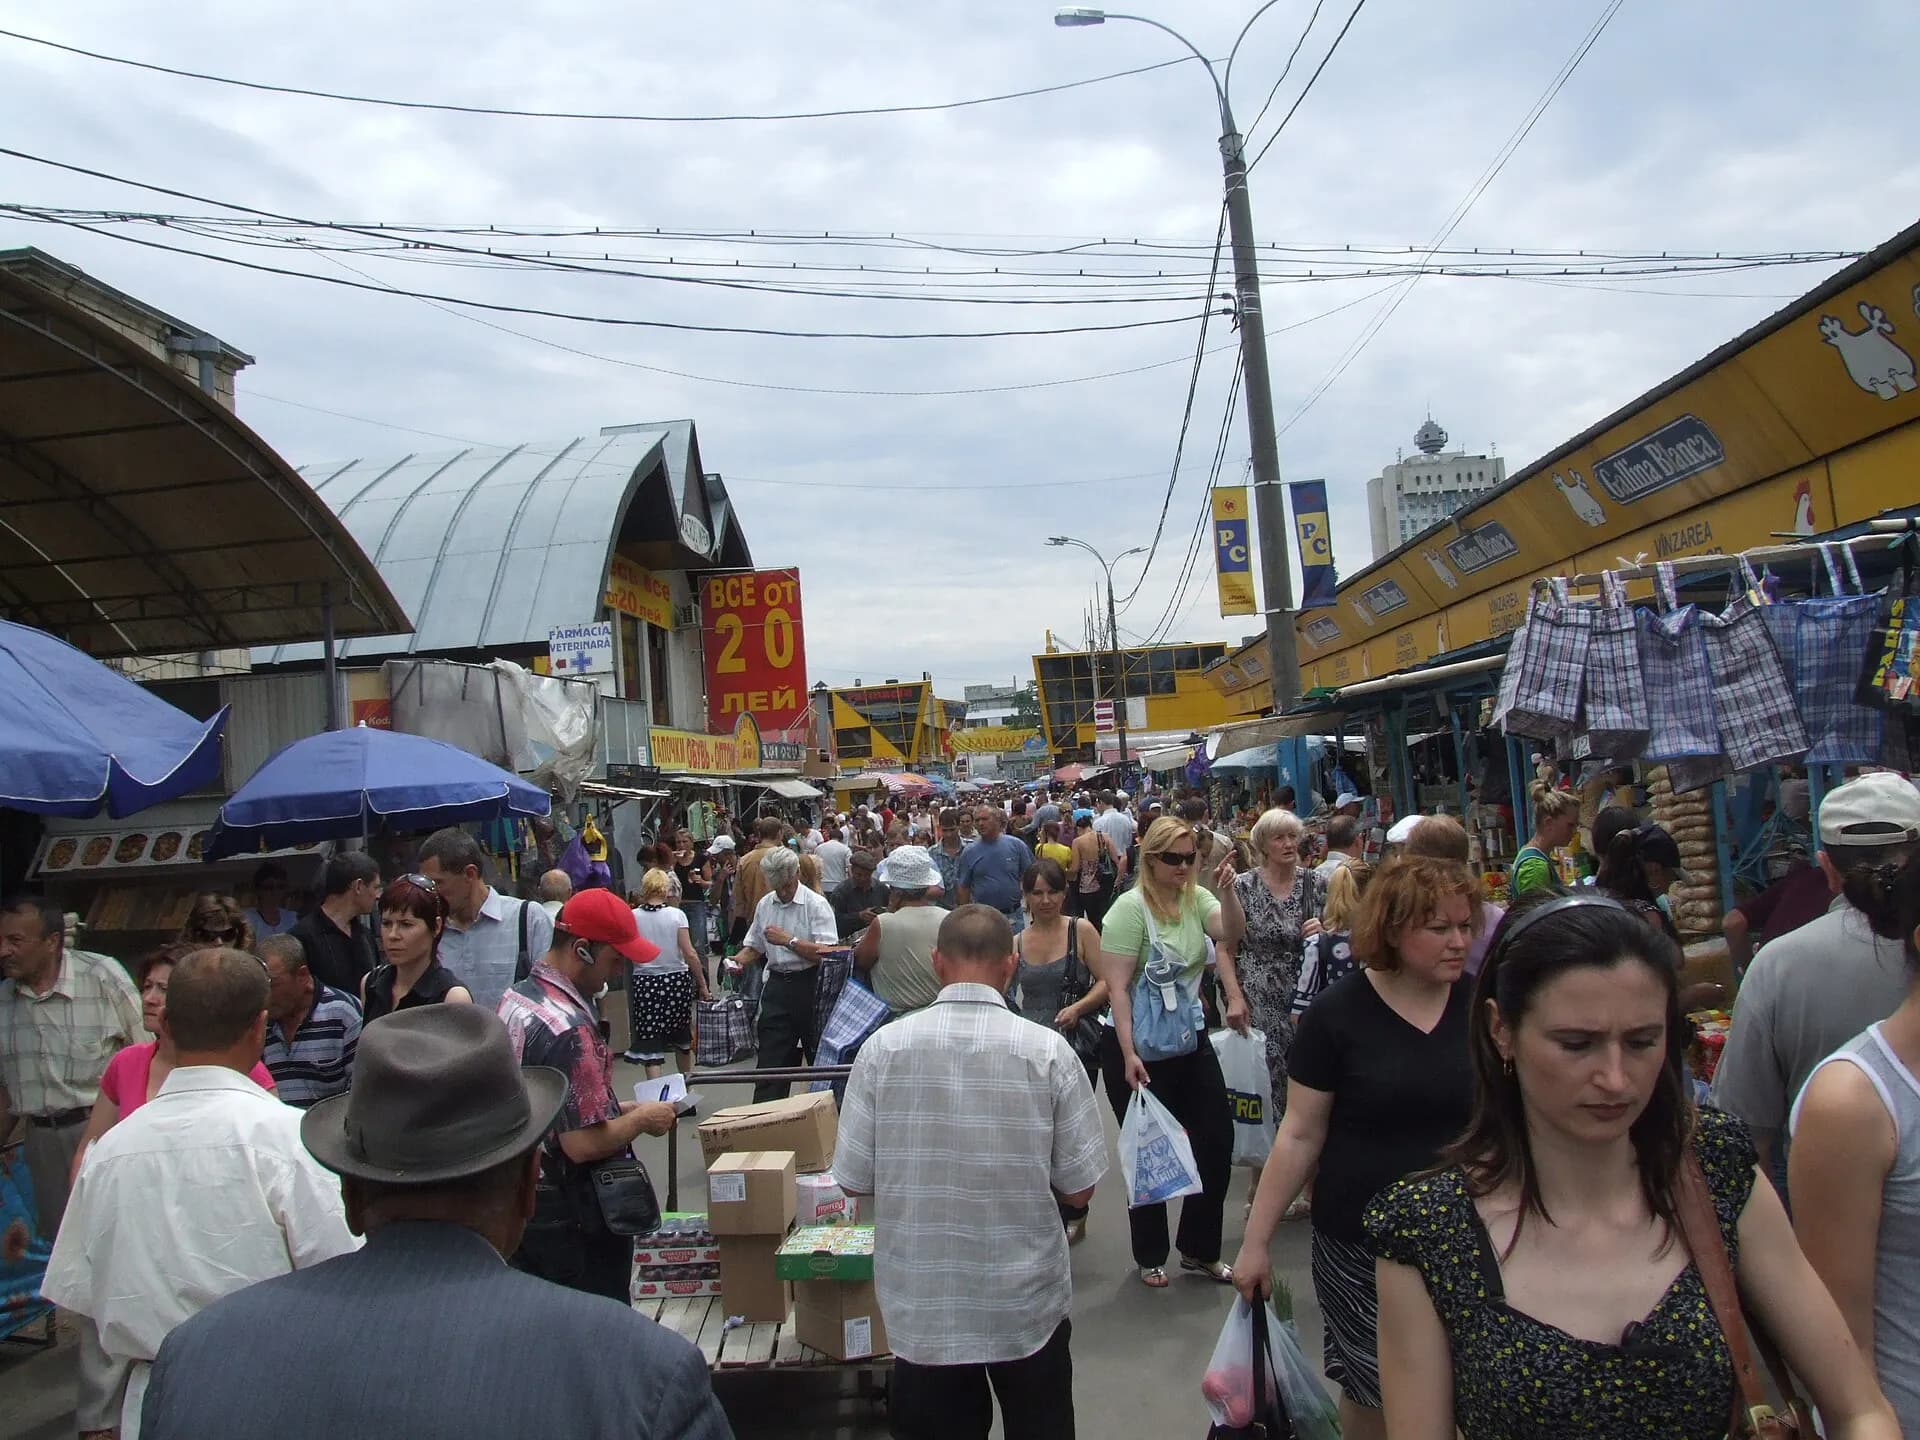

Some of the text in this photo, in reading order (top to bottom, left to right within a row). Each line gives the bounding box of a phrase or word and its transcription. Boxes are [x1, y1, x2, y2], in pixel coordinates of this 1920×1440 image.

[1599, 433, 1718, 498] Gallina Blanca
[617, 587, 636, 614] 20
[709, 576, 757, 609] ВСЕ
[549, 625, 611, 641] FARMACIA
[719, 684, 797, 715] ЛЕЙ
[651, 735, 686, 764] ТАПОЧКИ
[686, 738, 711, 770] ОБУВЬ
